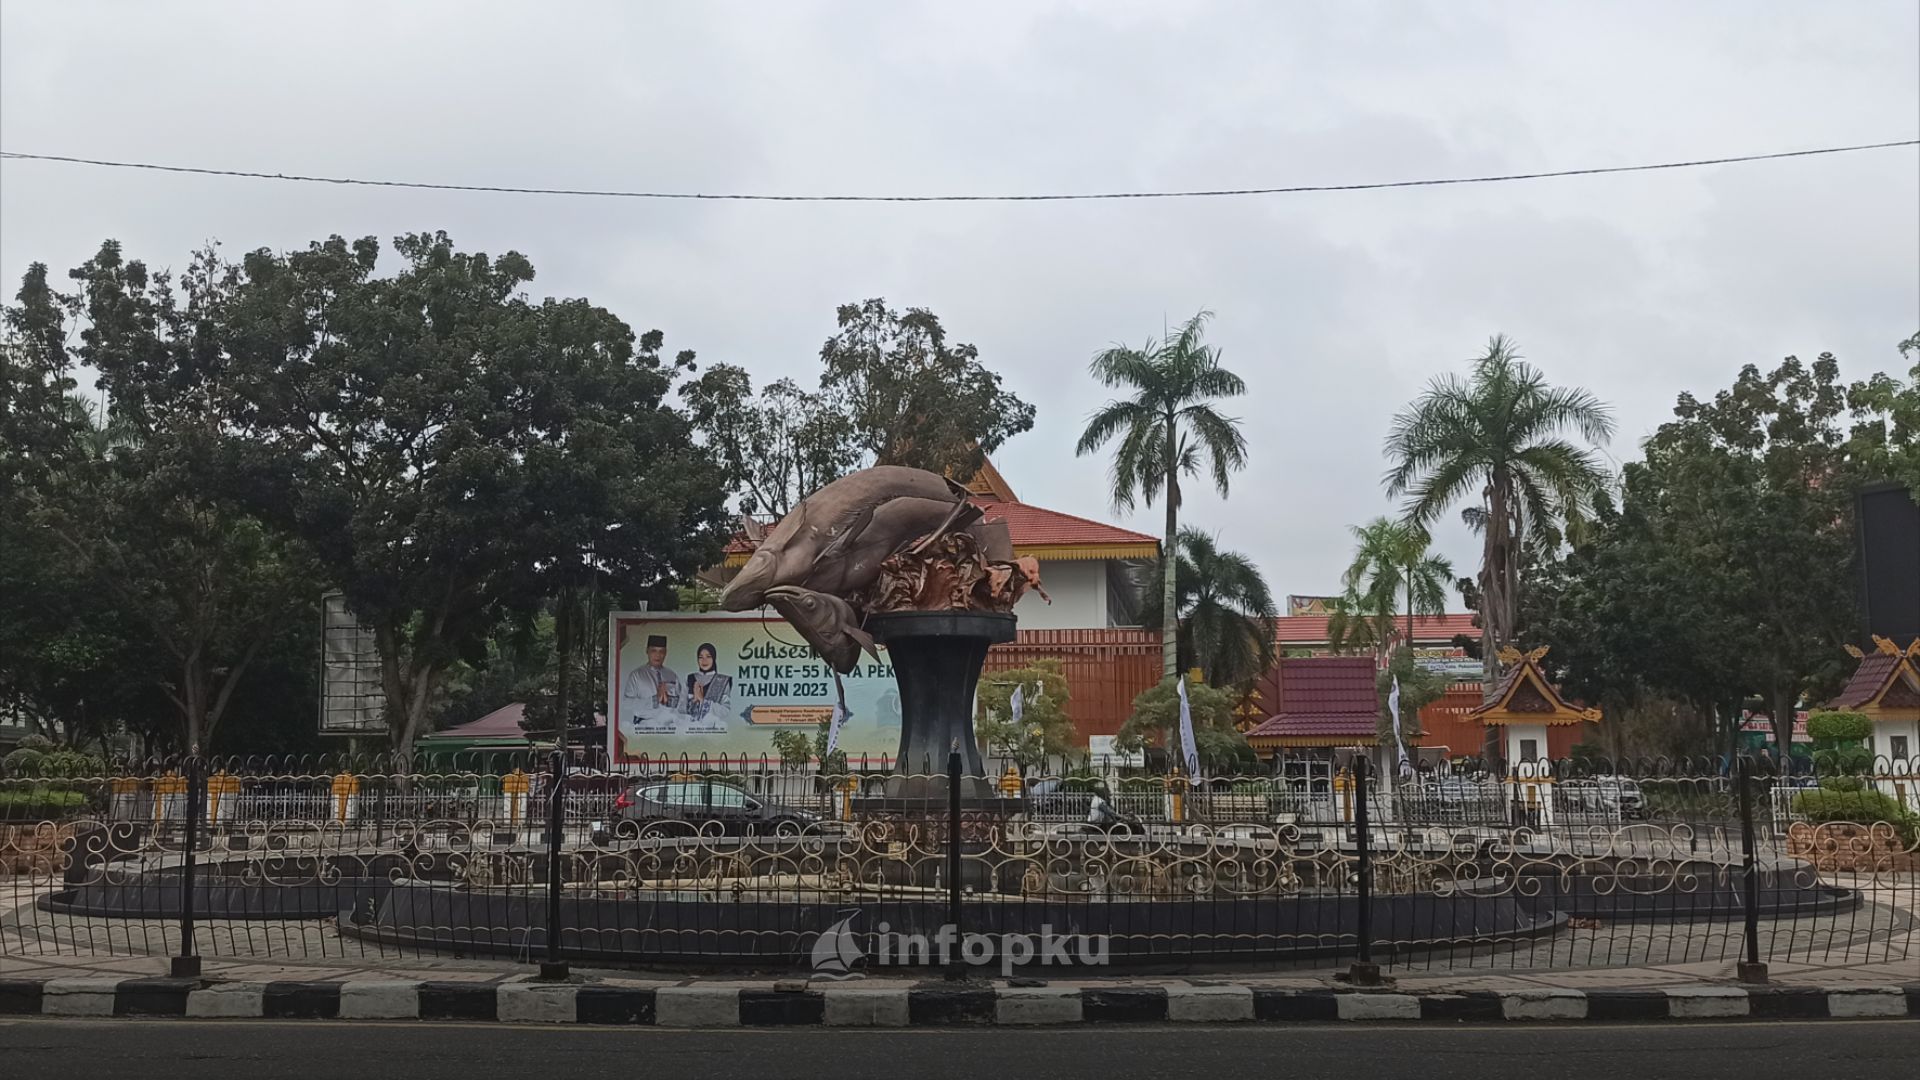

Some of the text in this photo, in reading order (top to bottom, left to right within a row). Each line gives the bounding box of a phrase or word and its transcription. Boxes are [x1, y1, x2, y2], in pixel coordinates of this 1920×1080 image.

[738, 665, 770, 681] MTQ
[774, 665, 820, 679] KE-55
[738, 683, 828, 697] TAHUN 2023
